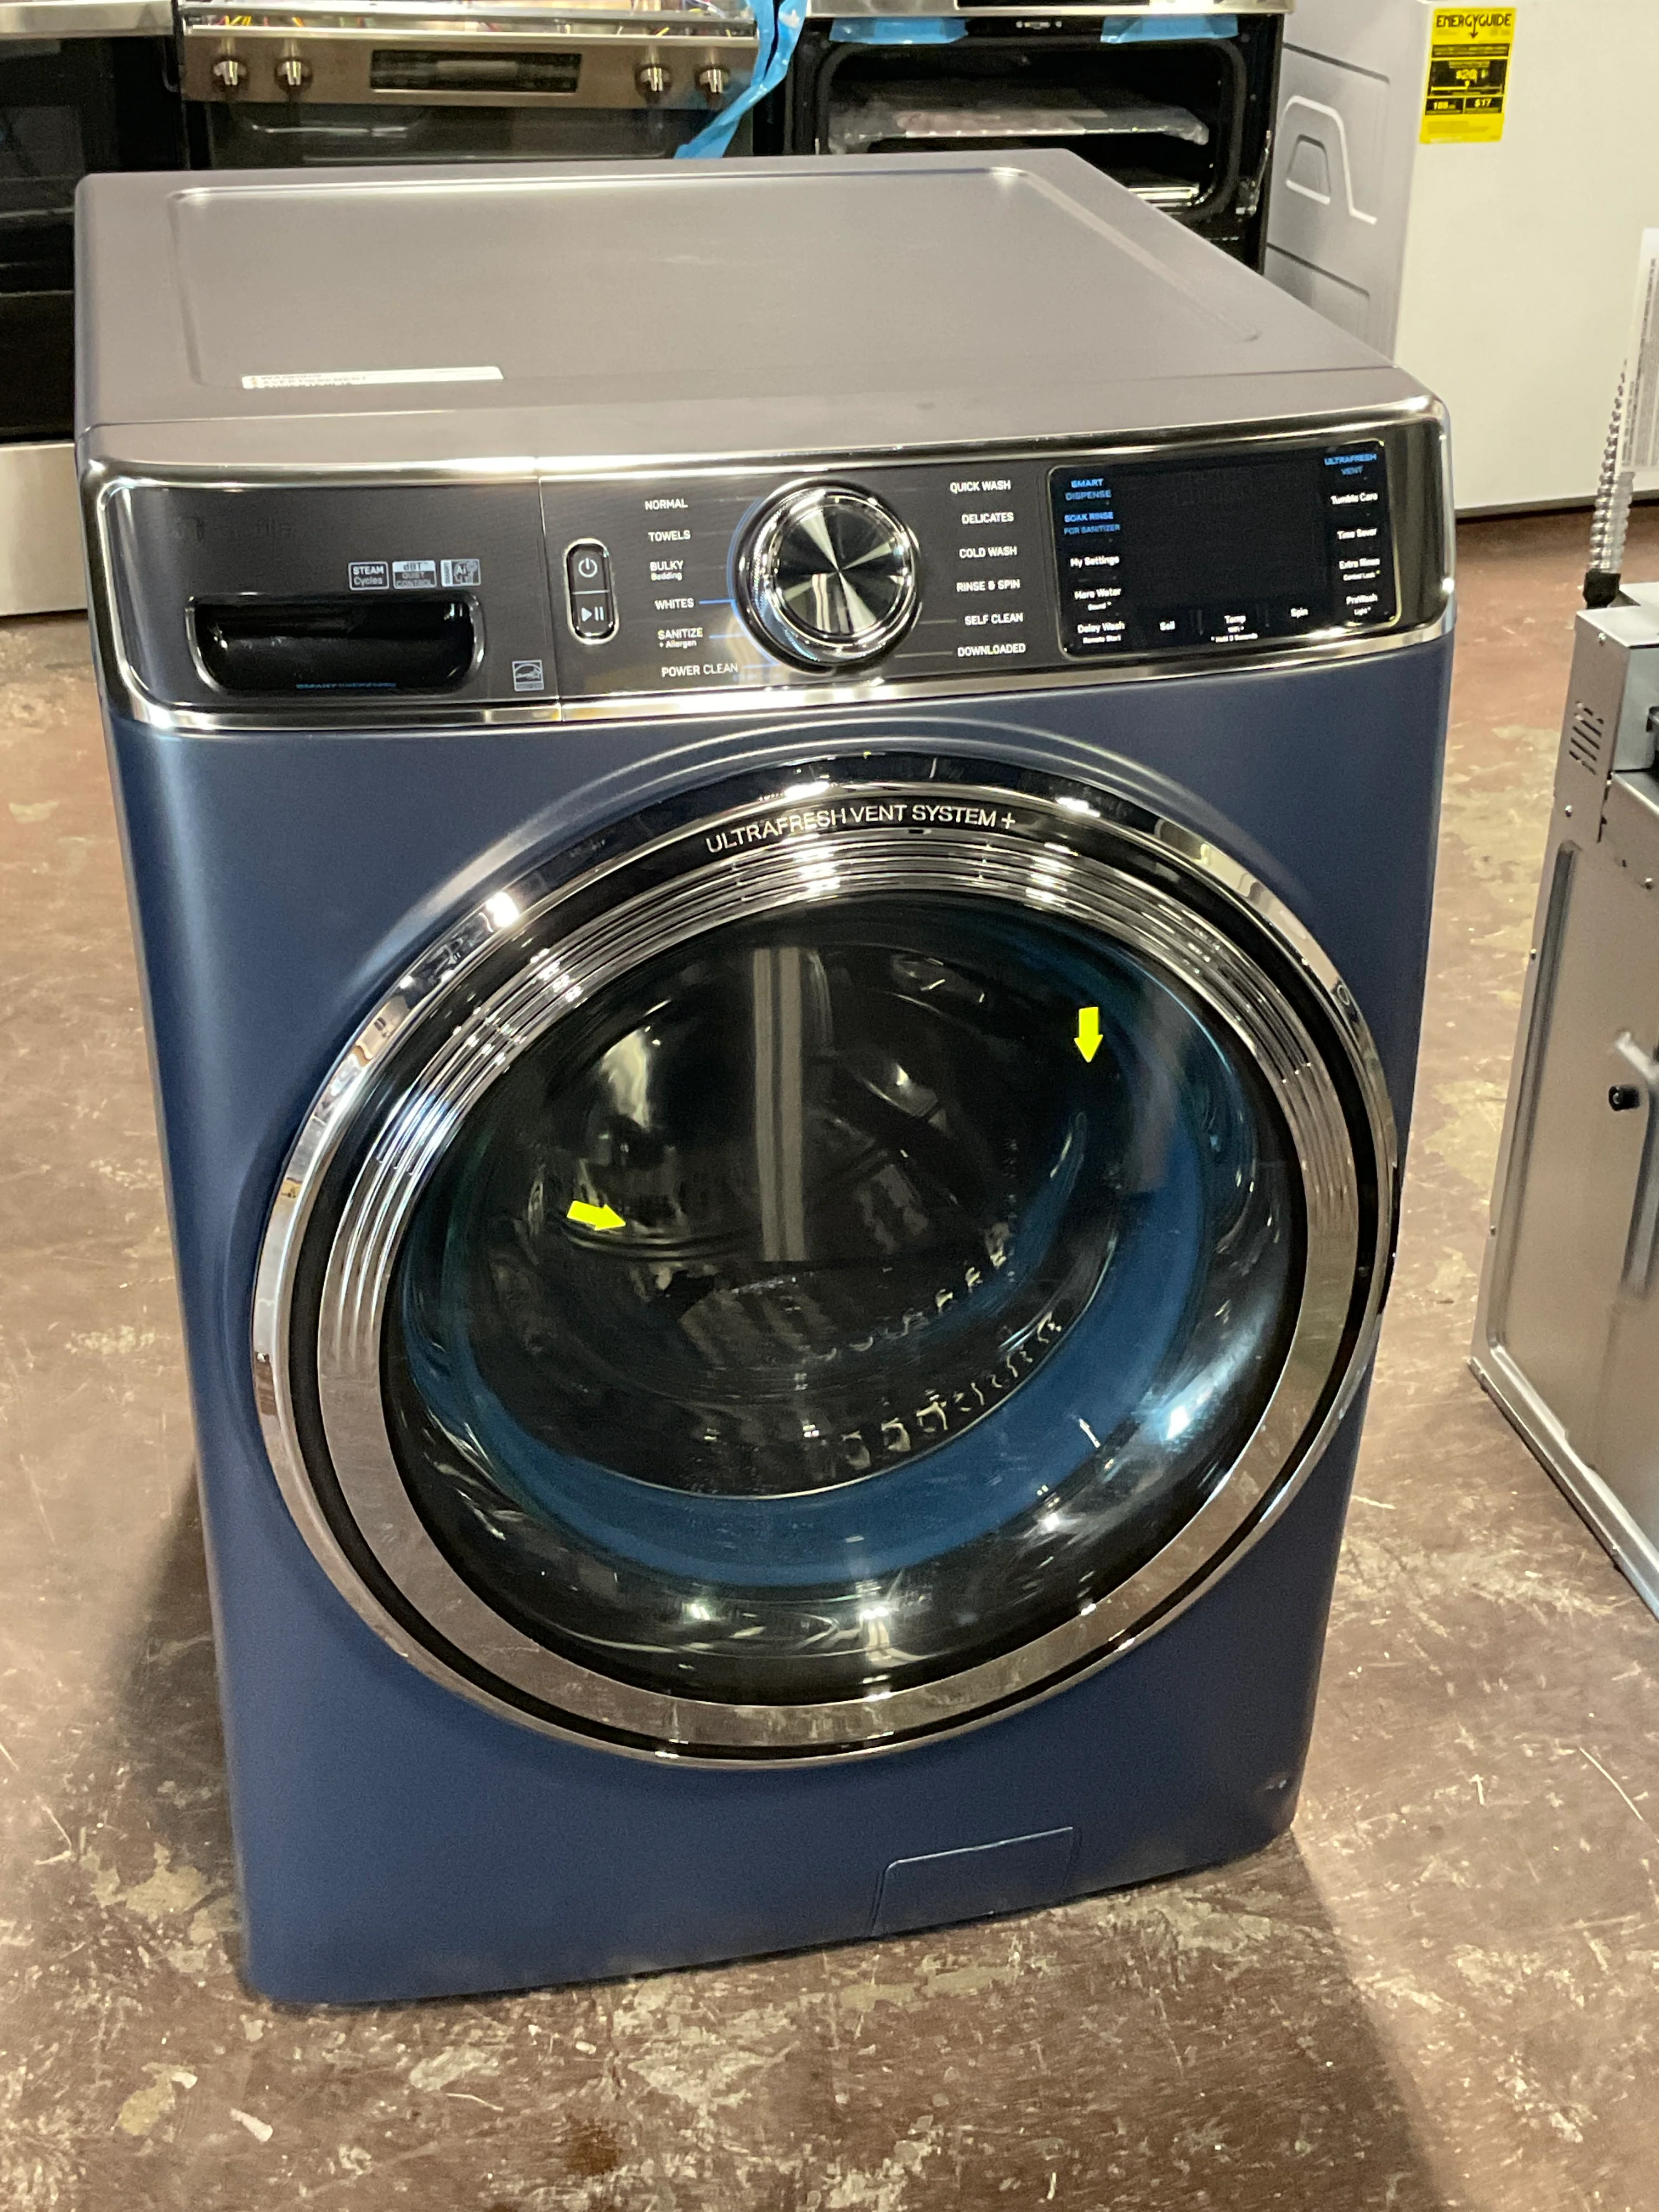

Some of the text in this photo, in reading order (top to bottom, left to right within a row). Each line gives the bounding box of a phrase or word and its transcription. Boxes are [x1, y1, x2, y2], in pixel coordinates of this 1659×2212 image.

[950, 479, 1011, 494] QUICK WASH
[644, 498, 689, 510] NORMAL
[961, 511, 1014, 524] DELICATES
[647, 529, 691, 542] TOWELS
[959, 546, 1017, 558] COLD WASH
[649, 559, 684, 571] BULKY
[1070, 555, 1120, 568] My Settings
[353, 566, 384, 575] STEAM
[353, 577, 383, 588] Cycles
[956, 580, 986, 592] RINSE
[997, 579, 1020, 590] SPIN
[1074, 588, 1121, 600] More Water
[654, 597, 695, 610] WHITES
[964, 612, 1024, 626] SELF CLEAN
[657, 627, 703, 640] SANITIZE
[957, 643, 1026, 657] DOWNLOADED
[661, 662, 739, 678] POWER CLEAN
[706, 804, 1017, 854] ULTRAFRESH VENT SYSTEM +
